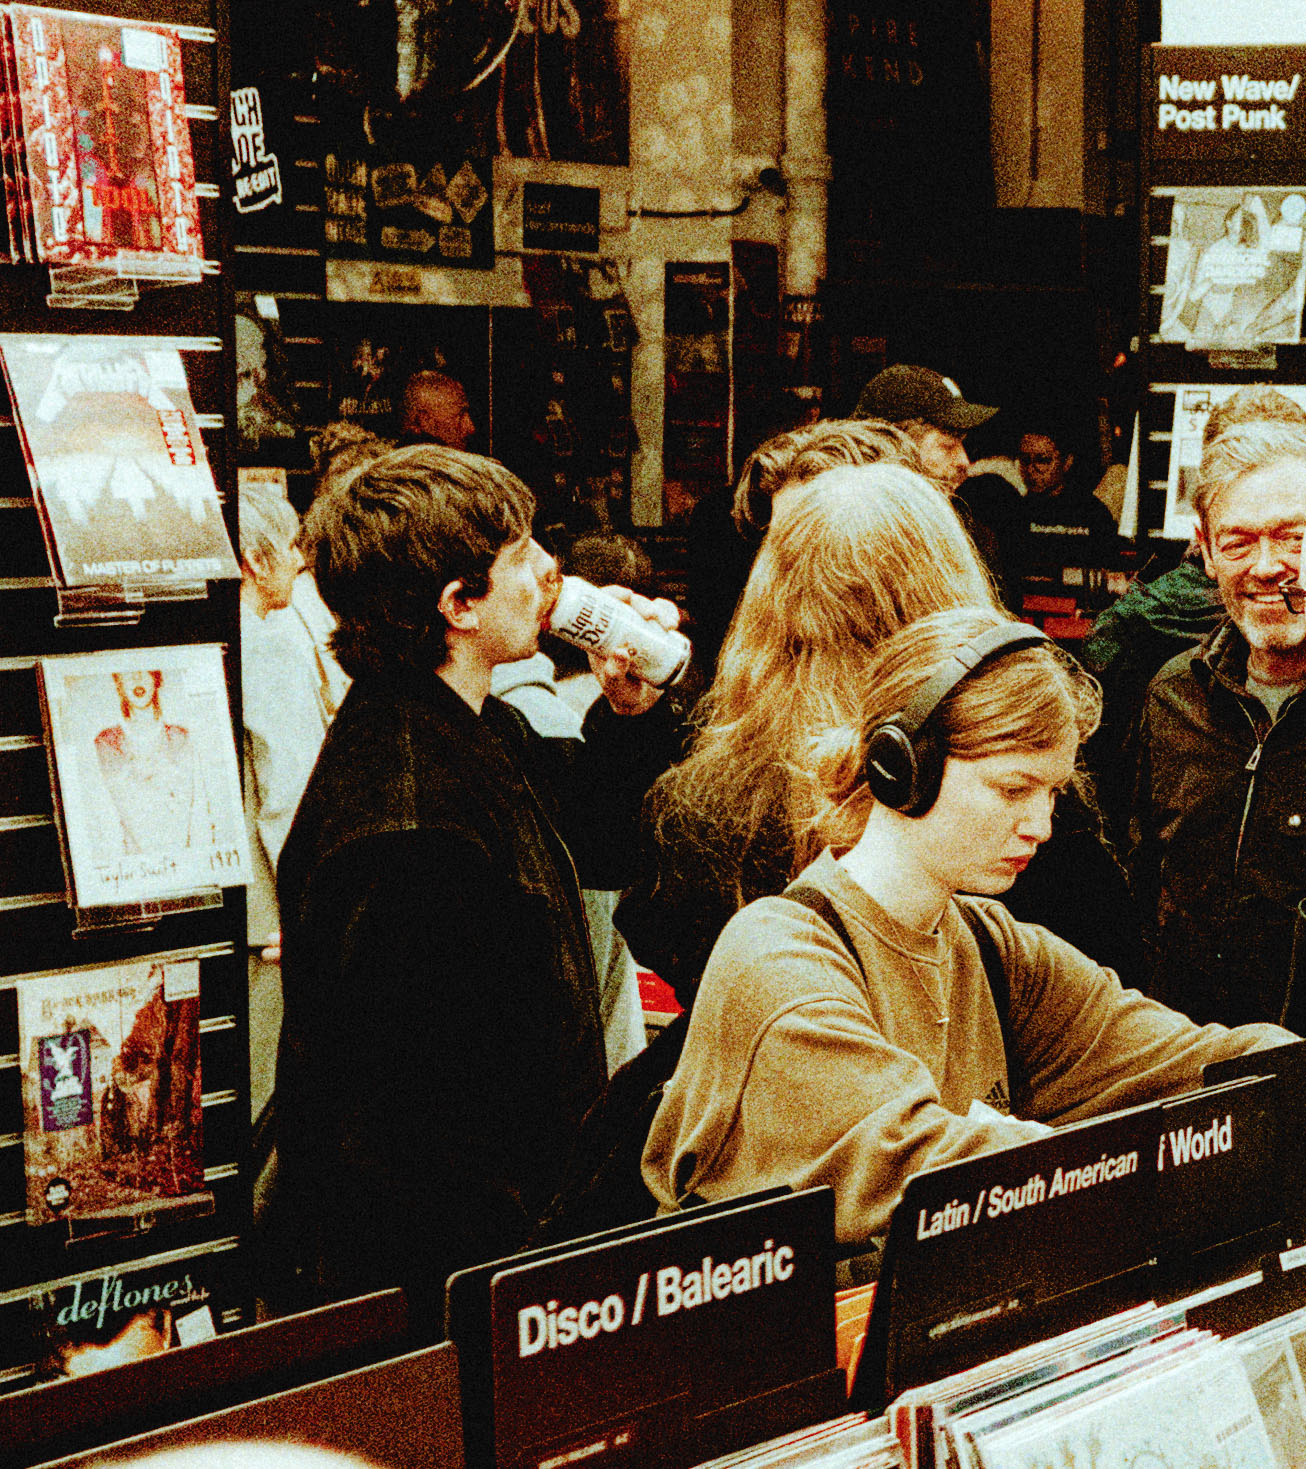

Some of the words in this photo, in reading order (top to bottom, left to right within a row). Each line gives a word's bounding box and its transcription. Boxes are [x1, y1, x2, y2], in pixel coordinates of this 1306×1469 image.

[1158, 73, 1217, 101] New
[1221, 73, 1299, 101] Wave/
[1158, 104, 1217, 130] Post
[1222, 104, 1287, 131] Punk
[82, 560, 141, 576] MASTER
[142, 559, 161, 573] OF
[209, 849, 241, 873] 1989
[1169, 1115, 1233, 1167] World
[917, 1199, 970, 1240] Latin
[972, 1190, 986, 1224] /
[987, 1173, 1047, 1219] South
[1049, 1151, 1138, 1199] American
[56, 1273, 196, 1329] deftones
[518, 1293, 625, 1358] Disco
[631, 1272, 649, 1326] /
[656, 1238, 795, 1317] Balearic
